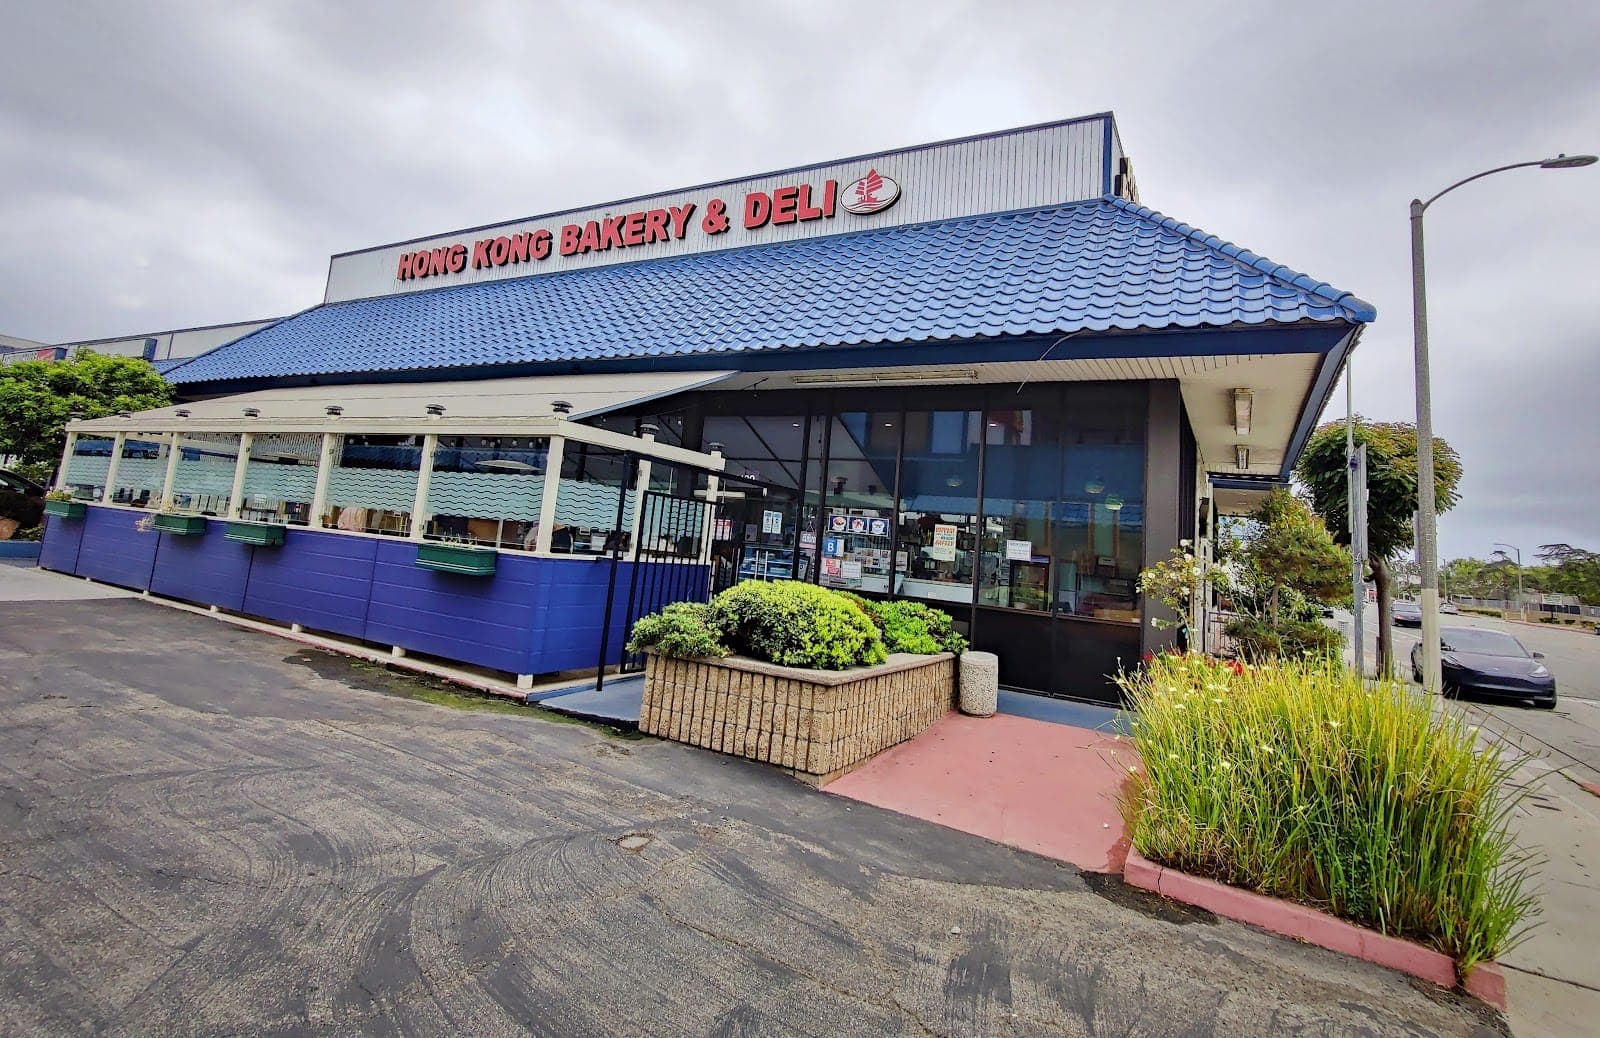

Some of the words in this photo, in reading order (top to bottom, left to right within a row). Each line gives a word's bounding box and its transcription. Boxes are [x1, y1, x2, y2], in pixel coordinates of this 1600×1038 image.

[397, 244, 466, 280] HONG
[472, 228, 552, 269] KONG
[559, 203, 695, 255] BAKERY
[701, 199, 730, 235] &
[743, 179, 838, 229] DELI
[827, 542, 834, 552] B
